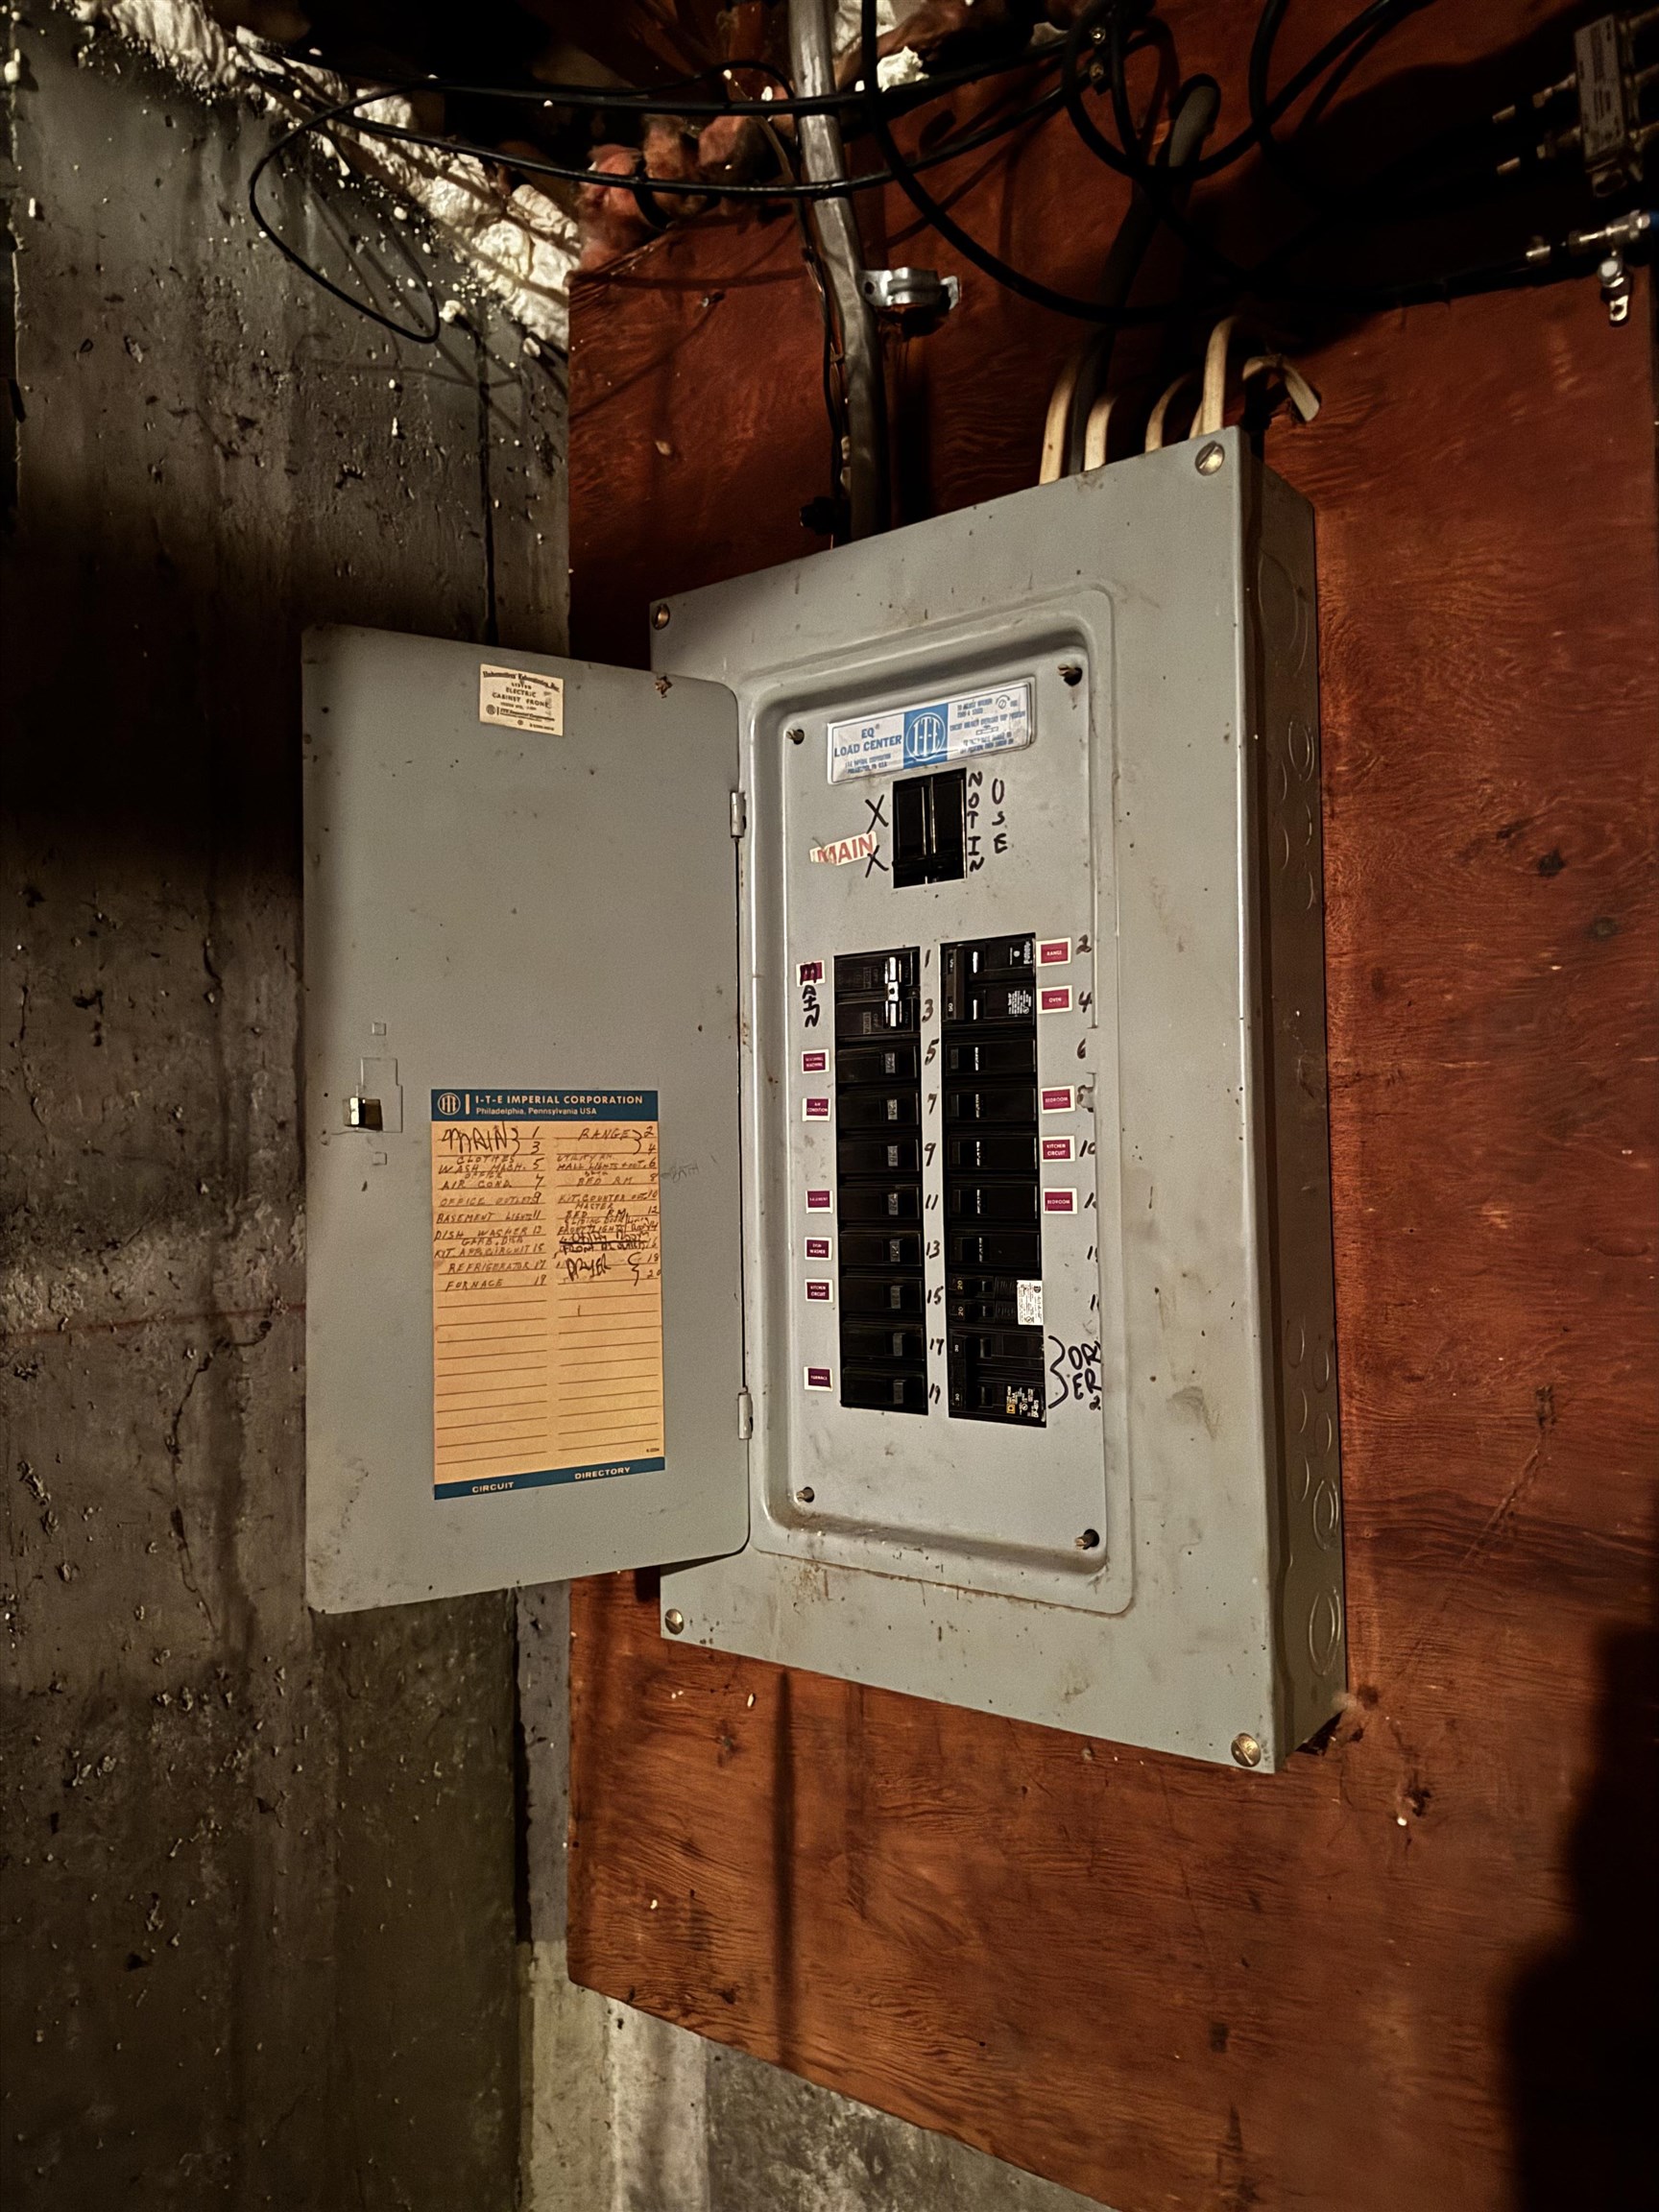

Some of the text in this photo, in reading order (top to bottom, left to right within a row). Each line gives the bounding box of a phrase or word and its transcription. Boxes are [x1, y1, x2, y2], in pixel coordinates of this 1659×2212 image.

[861, 727, 875, 738] EQ
[834, 734, 902, 757] LOAD CENTER
[817, 833, 873, 865] MAIN
[1078, 990, 1093, 1014] 4
[922, 998, 933, 1022] 3
[925, 1038, 939, 1066] 5
[475, 1095, 642, 1104] I-T-E IMPERIAL CORPORATION
[927, 1093, 937, 1115] 7
[441, 1121, 507, 1153] MAIN
[578, 1128, 631, 1141] RANGE
[644, 1126, 654, 1138] 2
[531, 1142, 541, 1155] 3
[648, 1144, 657, 1155] 4
[925, 1142, 936, 1166] 9
[439, 1165, 479, 1174] WASH
[534, 1158, 544, 1169] 5
[457, 1155, 515, 1165] CLOTHES
[649, 1157, 656, 1167] 6
[442, 1180, 466, 1190] AIR
[437, 1213, 494, 1224] BASEMENT
[434, 1230, 464, 1241] DISH
[478, 1228, 527, 1238] WASHER
[926, 1240, 940, 1259] 13
[448, 1262, 529, 1273] REFRIGERATOR
[445, 1279, 503, 1292] FURNACE
[927, 1286, 944, 1305] 15
[929, 1337, 945, 1356] 17
[574, 1467, 632, 1480] DIRECTORY
[472, 1481, 515, 1494] CIRCUIT
